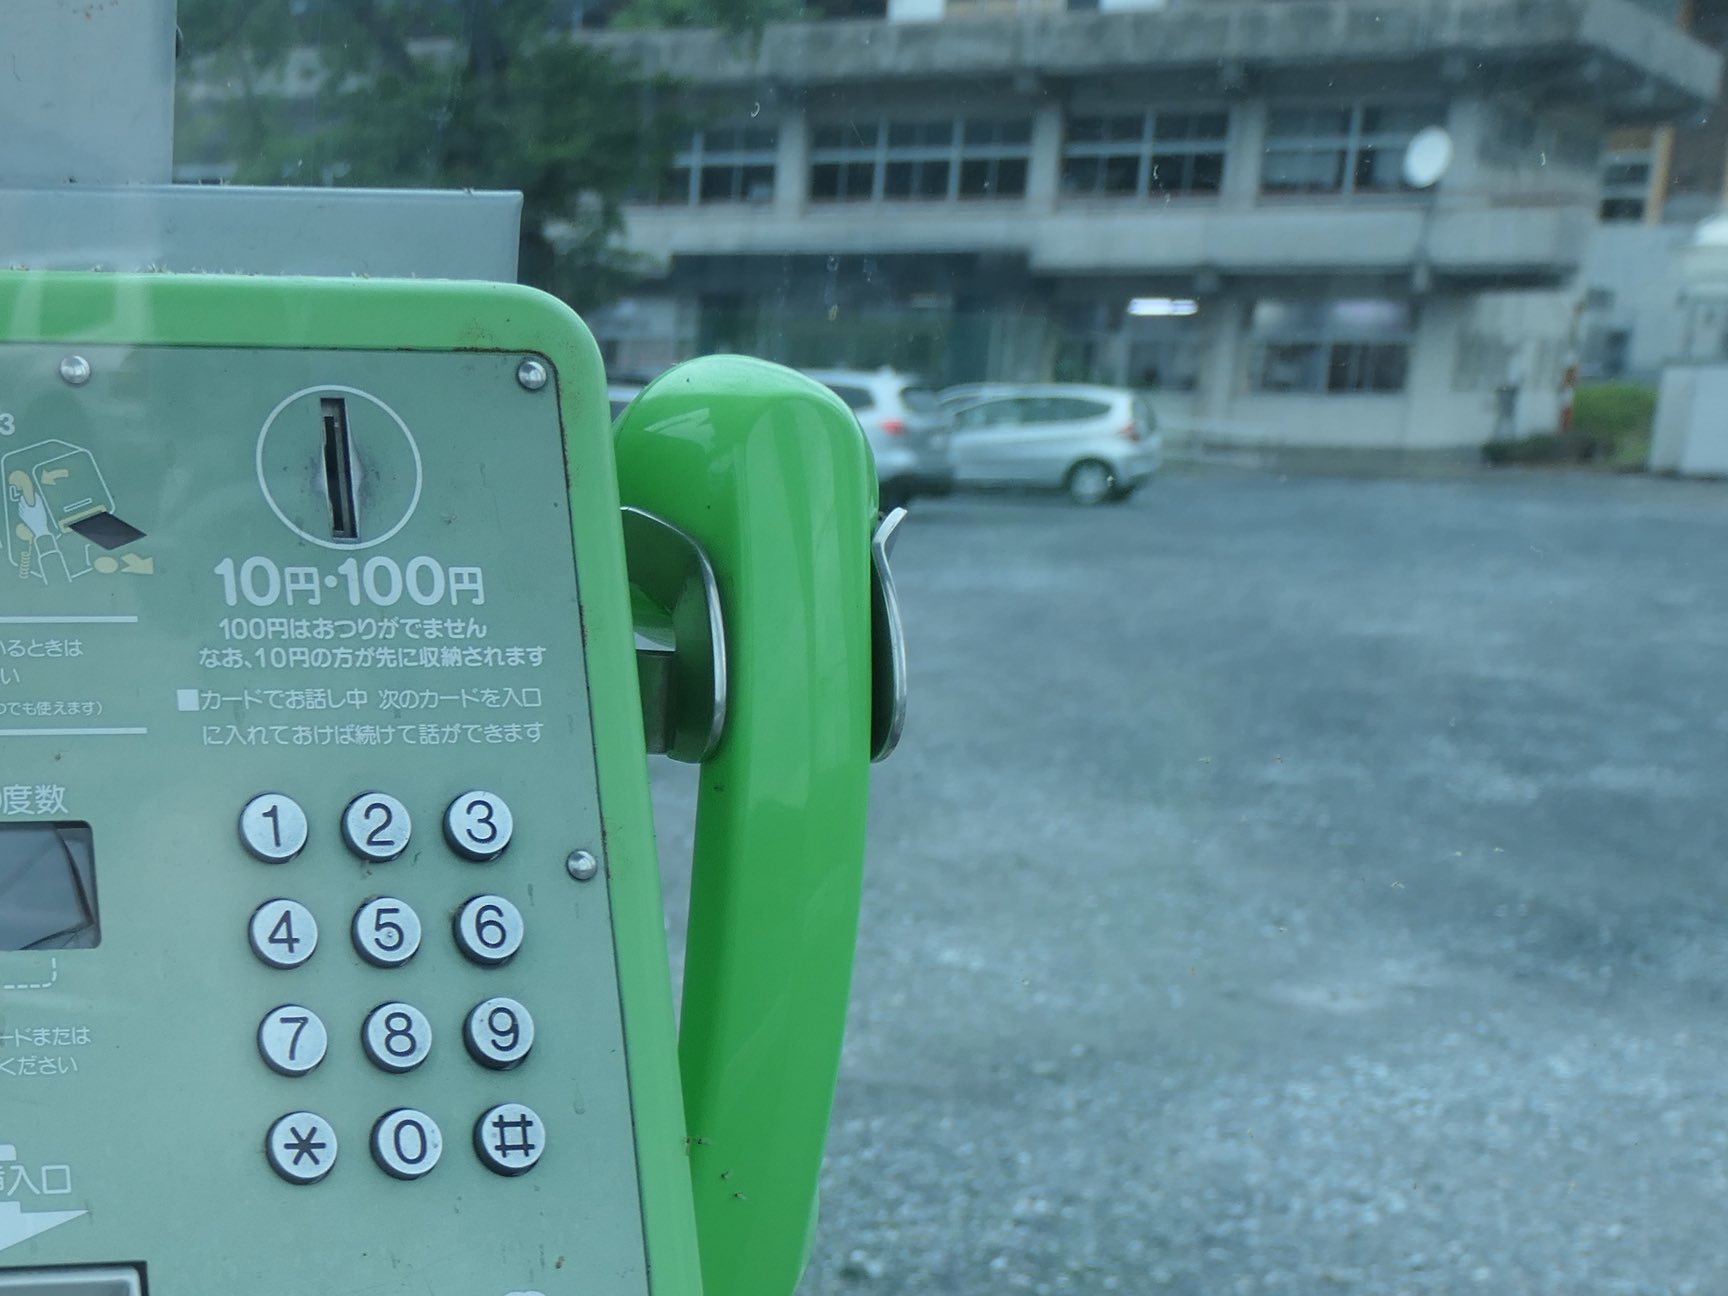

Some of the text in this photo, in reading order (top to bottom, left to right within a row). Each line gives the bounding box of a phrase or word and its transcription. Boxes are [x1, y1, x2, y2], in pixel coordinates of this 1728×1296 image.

[218, 616, 487, 641] 100円はおつりがでません
[198, 645, 546, 670] なお、10円の方が先に収納されます
[201, 686, 542, 710] カードでお話し中 次のカードを入口
[202, 721, 544, 746] に入れておけば続けて話ができます
[262, 804, 282, 847] 1
[364, 802, 395, 846] 2
[466, 799, 497, 844] 3
[268, 909, 300, 953] 4
[374, 907, 404, 951] 5
[475, 904, 507, 949] 6
[279, 1016, 309, 1061] 7
[384, 1012, 417, 1057] 8
[488, 1006, 520, 1052] 9
[393, 1119, 427, 1164] 0
